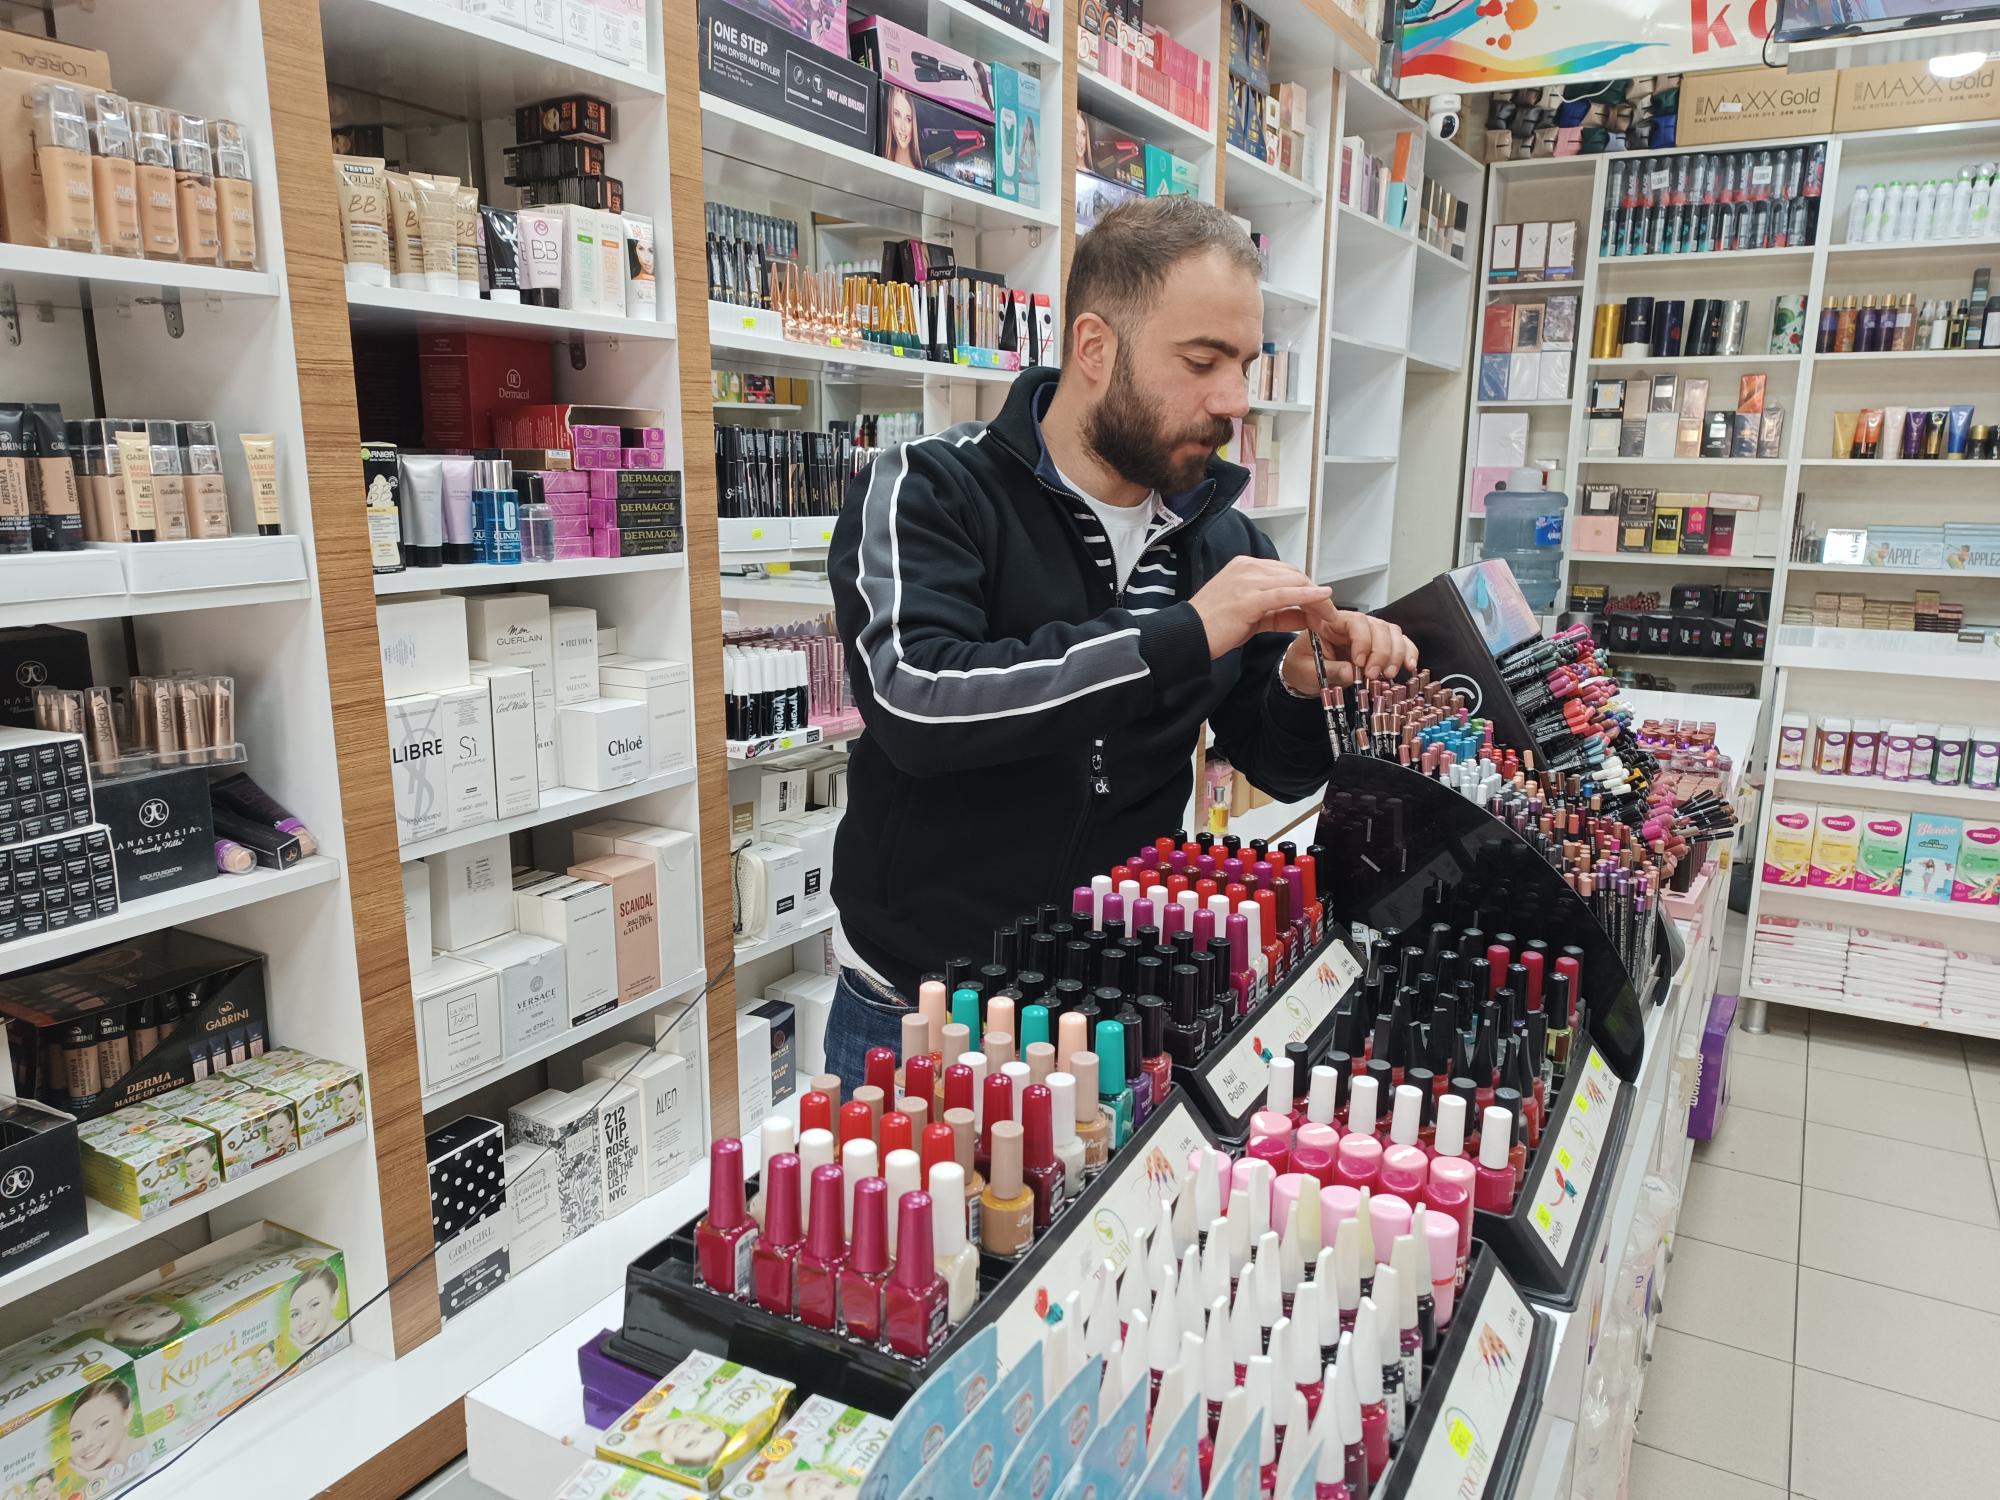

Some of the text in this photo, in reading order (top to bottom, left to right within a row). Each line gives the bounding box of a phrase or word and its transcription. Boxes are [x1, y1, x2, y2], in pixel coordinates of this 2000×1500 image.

[714, 21, 768, 56] ONE STEP
[714, 41, 727, 54] HAIR
[728, 45, 748, 62] DRYER
[747, 55, 760, 68] AND
[760, 59, 780, 78] STYLER
[1949, 69, 1994, 91] Gold
[827, 88, 838, 101] HOT
[838, 93, 847, 105] AIR
[848, 97, 865, 114] BRUSH
[1780, 87, 1820, 106] Gold
[344, 165, 374, 173] TESTER
[349, 194, 377, 213] BB
[405, 211, 420, 228] B
[532, 239, 559, 261] BB
[499, 387, 530, 400] Dermacol
[621, 474, 675, 482] DERMACOL
[620, 503, 675, 512] DERMACOL
[624, 530, 678, 540] DERMACOL
[1888, 549, 1920, 565] APPLE
[497, 634, 542, 646] GUERLAIN
[392, 738, 443, 764] LIBRE
[608, 736, 643, 757] Chloé
[1096, 779, 1110, 794] ck
[117, 826, 202, 851] ANASTASIA
[620, 892, 654, 917] SCANDAL
[517, 988, 556, 1009] VERSACE
[206, 1009, 249, 1031] GABRINI
[127, 1072, 171, 1094] DERMA
[156, 1078, 185, 1092] COVER
[1222, 1069, 1237, 1088] Nail
[1228, 1081, 1248, 1104] Polish
[604, 1106, 626, 1130] 212
[605, 1122, 626, 1144] VIP
[606, 1133, 630, 1159] ROSÉ
[608, 1145, 638, 1170] ARE YOU
[608, 1158, 633, 1180] ON THE
[608, 1171, 629, 1190] LIST?
[609, 1185, 627, 1203] NYC
[449, 1226, 495, 1260] GOOD GIRL
[1549, 1220, 1564, 1248] Polish
[241, 1319, 268, 1338] Beauty
[242, 1329, 267, 1346] Cream
[0, 1348, 104, 1411] Kanz
[165, 1404, 177, 1421] 3
[152, 1438, 167, 1452] 12
[3, 1449, 36, 1473] Beauty
[5, 1461, 36, 1483] Cream
